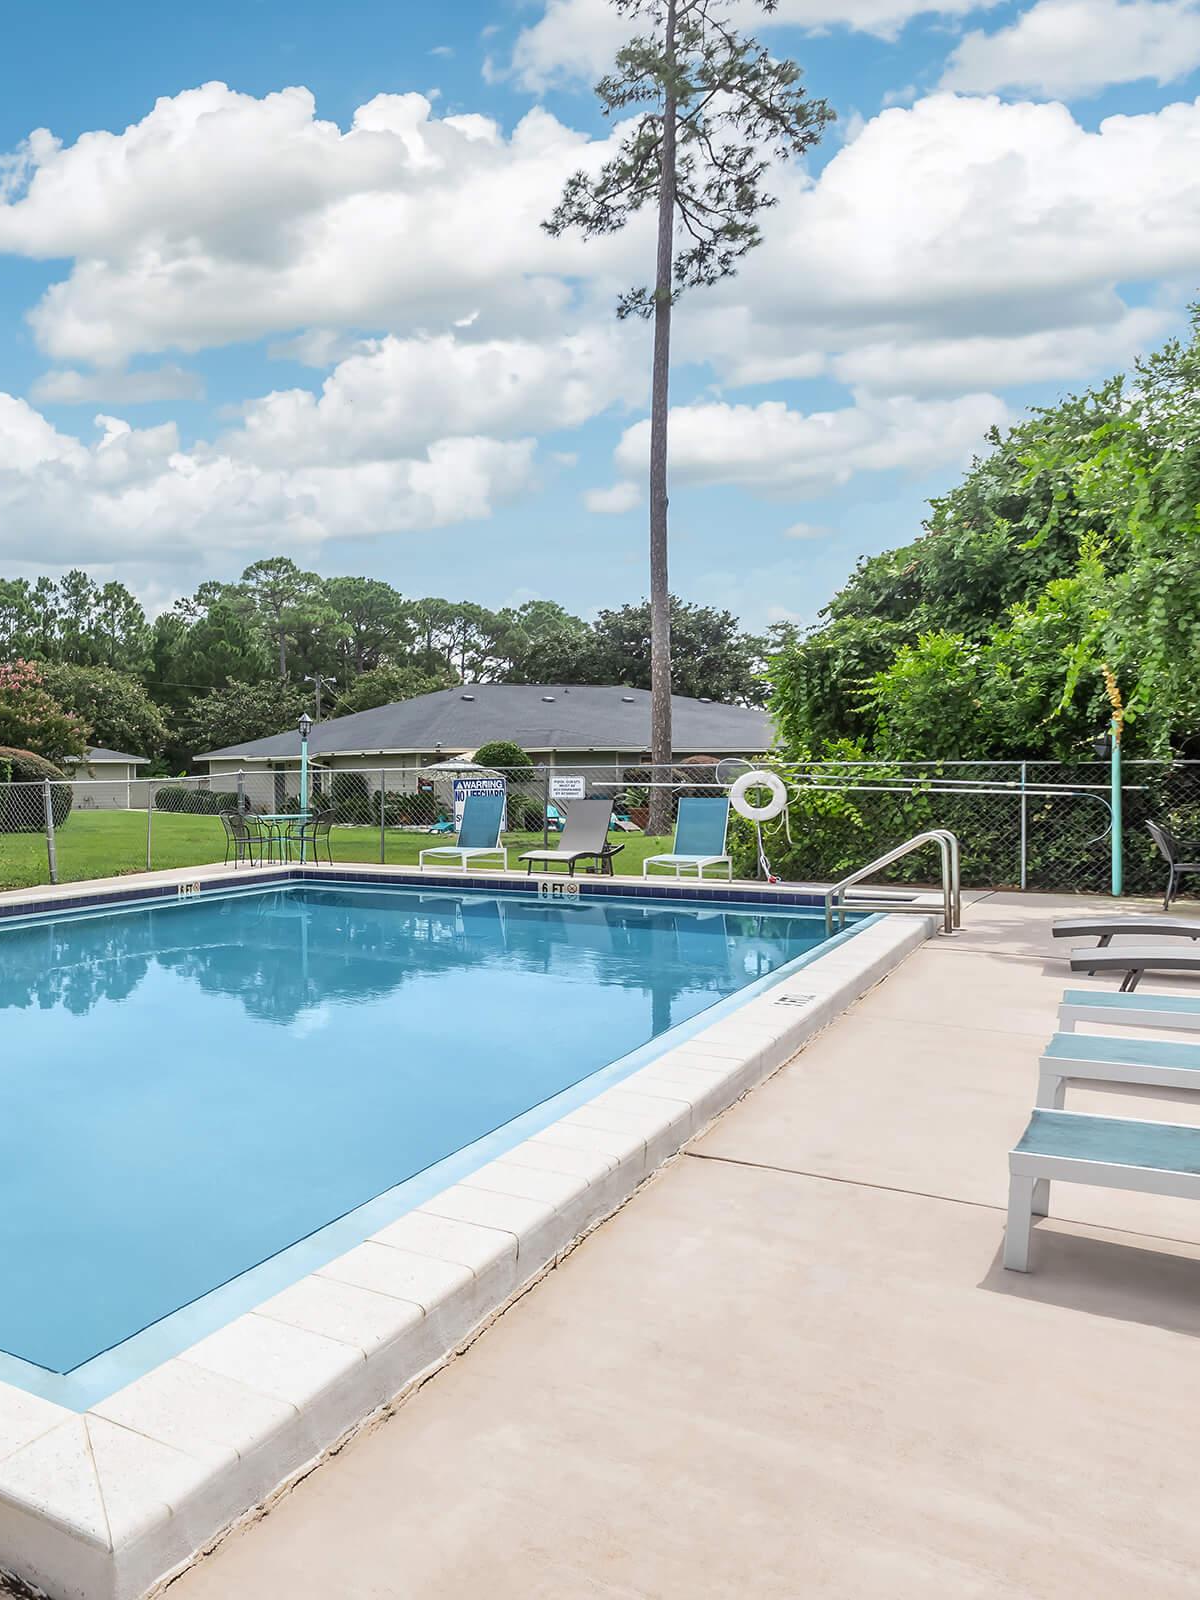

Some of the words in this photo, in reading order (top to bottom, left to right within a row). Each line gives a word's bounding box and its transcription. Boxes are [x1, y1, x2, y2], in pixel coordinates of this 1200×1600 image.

[462, 780, 503, 789] WARNING
[542, 882, 549, 893] 6
[552, 883, 565, 893] FT
